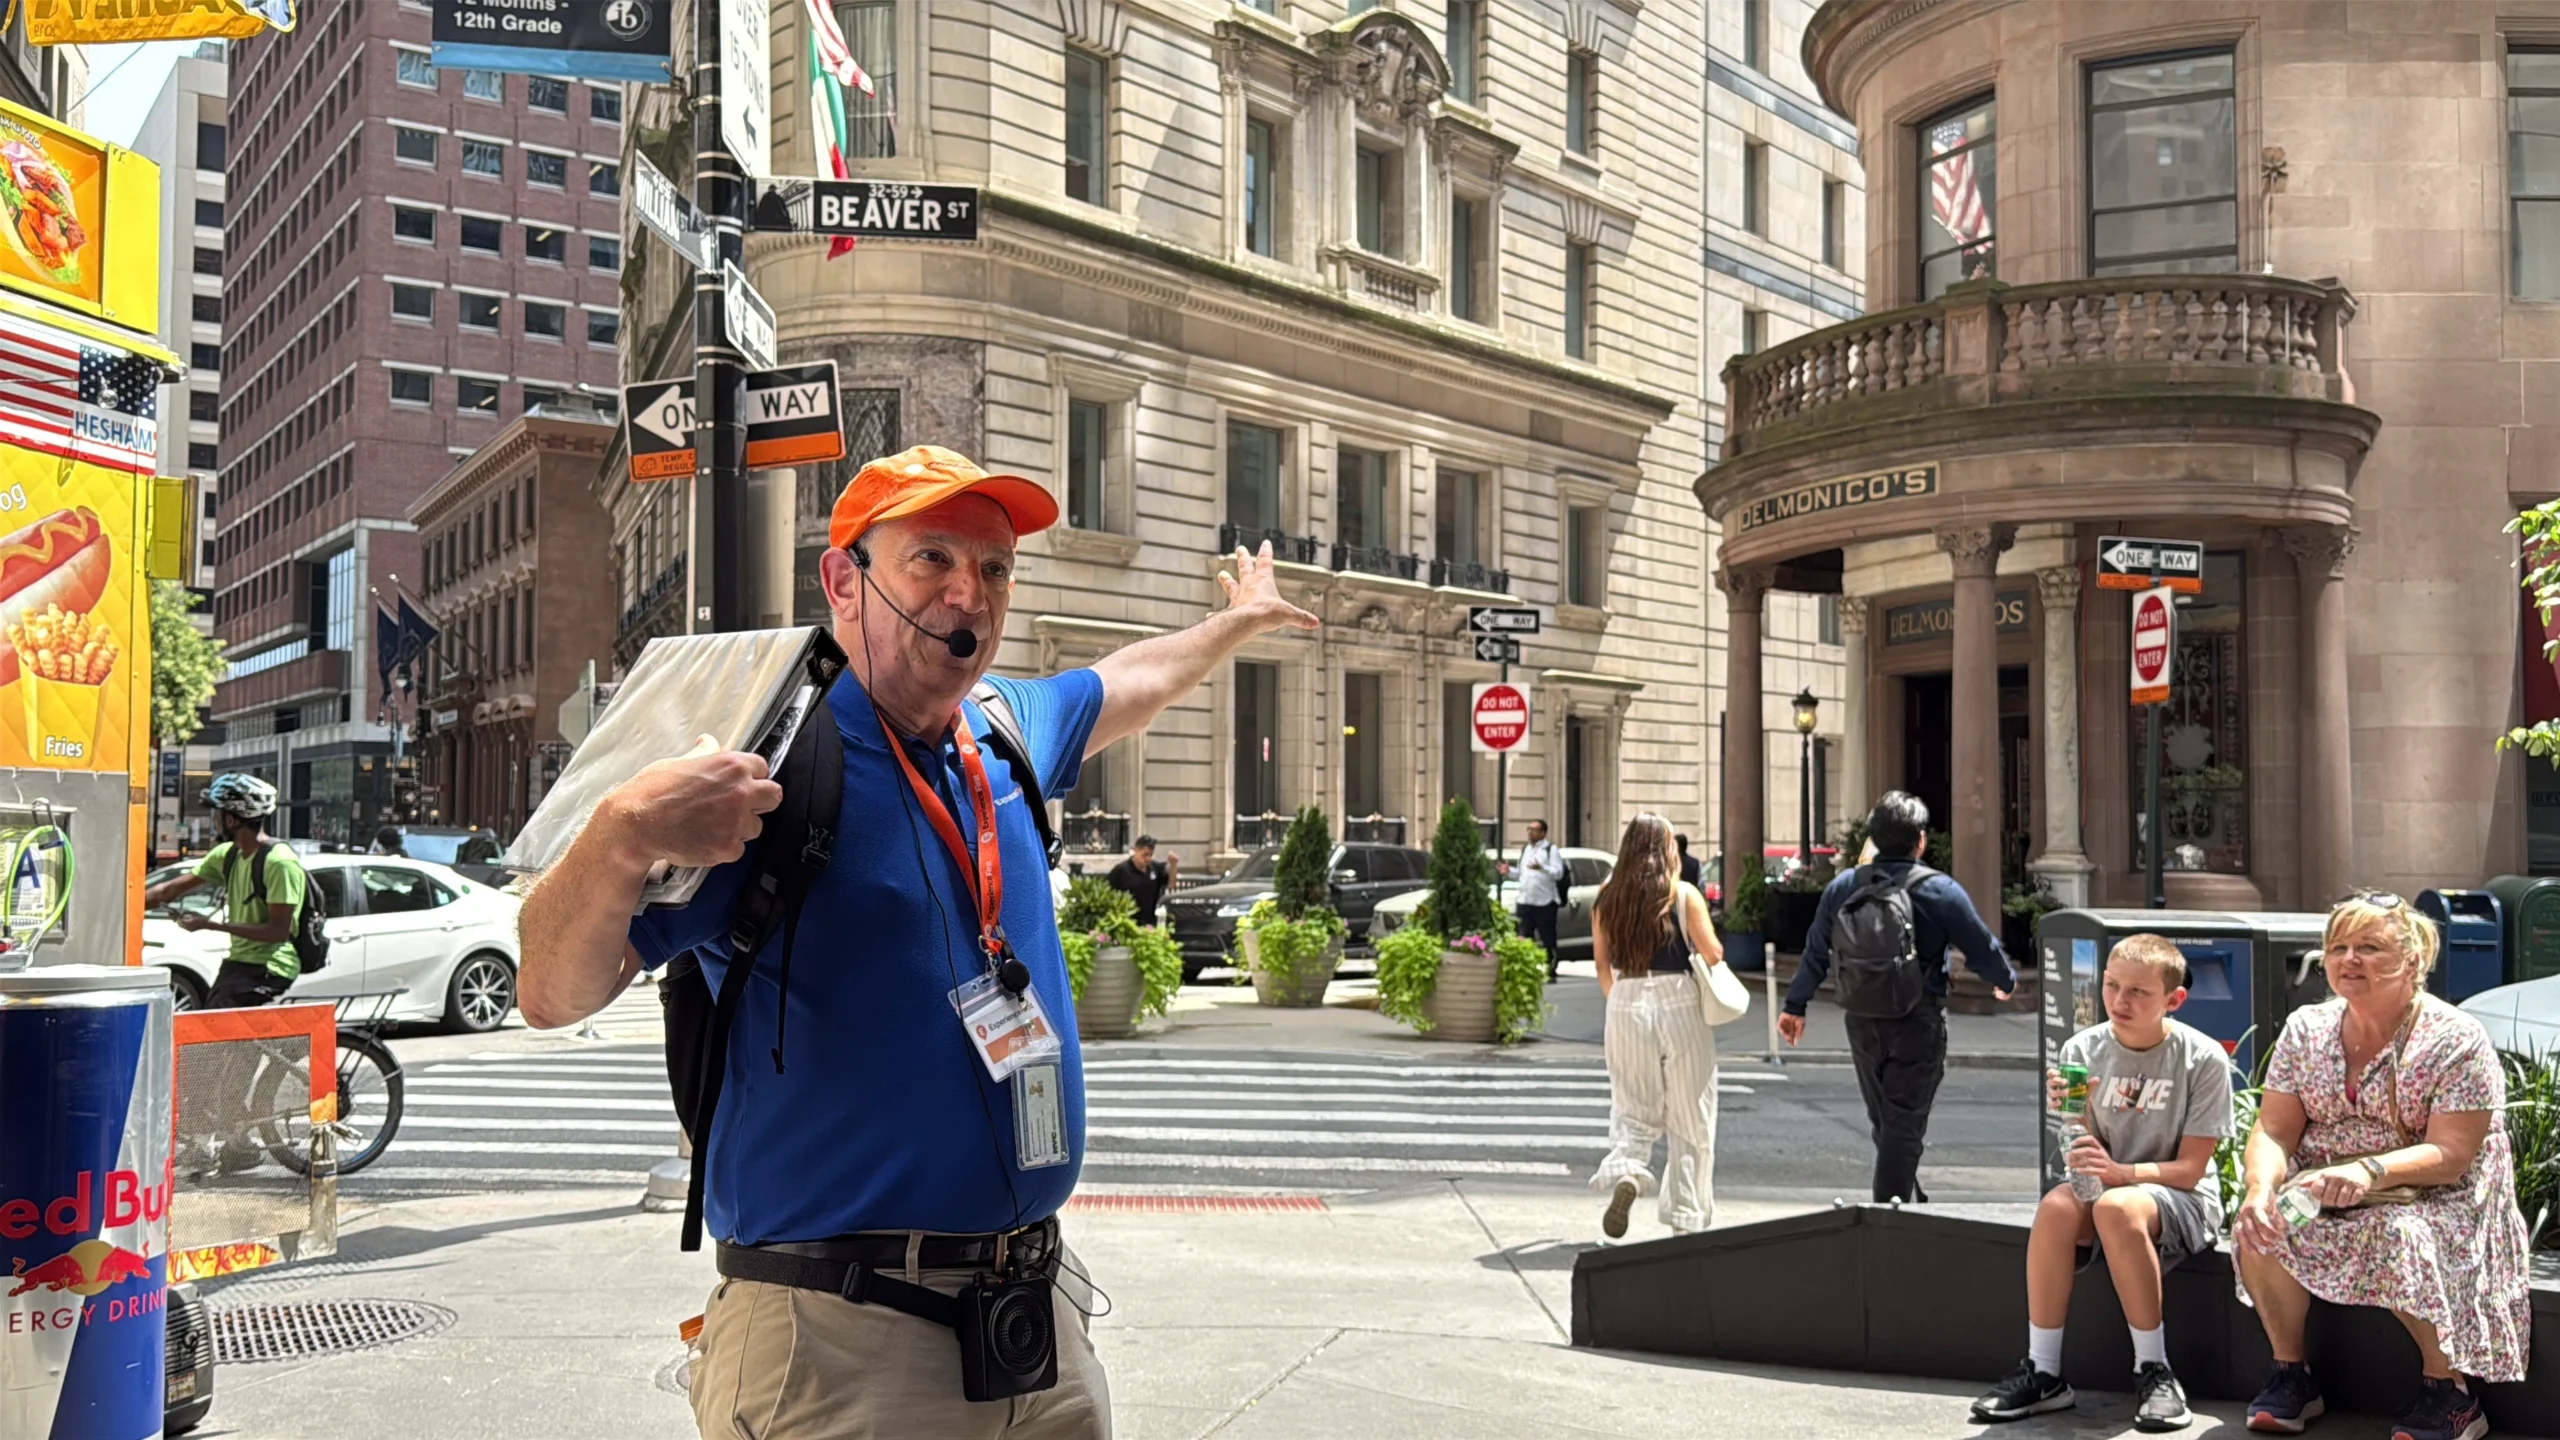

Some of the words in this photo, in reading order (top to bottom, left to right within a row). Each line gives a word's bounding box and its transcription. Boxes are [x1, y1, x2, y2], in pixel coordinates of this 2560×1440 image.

[453, 11, 496, 29] 12th
[501, 14, 563, 34] Grade
[743, 51, 764, 114] TONS
[13, 121, 41, 149] GYRO
[868, 184, 908, 199] 32-59
[821, 195, 942, 231] BEAVER
[947, 201, 970, 219] ST
[662, 402, 696, 430] ON
[760, 386, 820, 419] WAY
[76, 411, 153, 453] HESHAM
[0, 481, 27, 511] og
[1739, 470, 1927, 531] DELMONICO'S
[2116, 549, 2145, 566] ONE
[2164, 553, 2193, 569] WAY
[1480, 615, 1500, 626] ONE
[1512, 616, 1532, 626] WAY
[1890, 599, 2025, 638] DELMOOS
[2149, 608, 2163, 626] NOT
[2138, 649, 2162, 669] ENTER
[1482, 696, 1497, 709] DO
[1498, 695, 1519, 709] NOT
[45, 735, 84, 758] Fries
[1483, 725, 1516, 739] ENTER
[12, 845, 41, 888] A
[0, 1170, 92, 1239] ed
[104, 1158, 170, 1229] Bul
[8, 1303, 96, 1334] ERGY
[108, 1287, 166, 1323] DRIN
